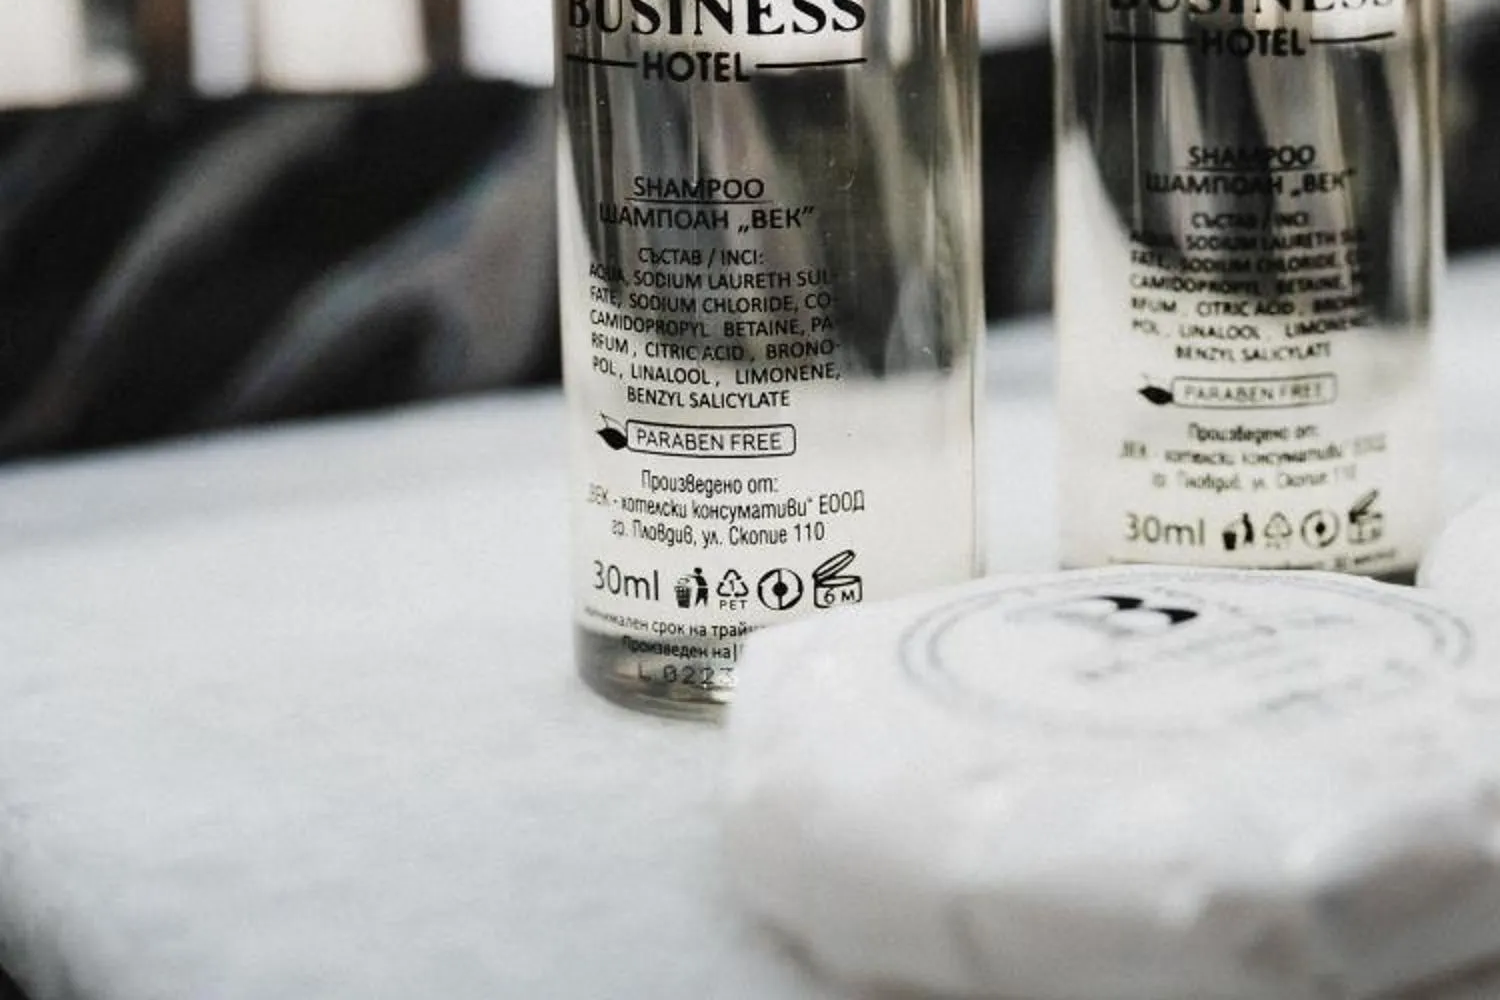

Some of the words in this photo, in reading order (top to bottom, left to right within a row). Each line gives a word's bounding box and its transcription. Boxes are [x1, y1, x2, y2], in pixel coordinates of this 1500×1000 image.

[1201, 28, 1307, 58] HOTEL
[642, 51, 750, 83] HOTEL
[633, 175, 765, 200] SHAMPOO
[600, 203, 729, 231] ШАМПОАН
[721, 249, 765, 266] INCI:
[633, 269, 703, 290] SODIUM
[707, 271, 792, 291] LAURETH
[628, 293, 697, 313] SODIUM
[701, 294, 799, 314] CHLORIDE,
[589, 308, 711, 339] CAMIDOPROPYL
[723, 318, 806, 338] BETAINE,
[645, 341, 699, 361] CITRIC
[735, 361, 842, 385] LIMONENE,
[627, 385, 685, 409] BENZYL
[689, 389, 791, 409] SALICYLATE
[636, 427, 724, 451] PARABEN
[730, 431, 783, 451] FREE
[641, 468, 743, 499] Произведено
[819, 489, 865, 515] ЕООД
[632, 518, 698, 548] Пловдив,
[728, 524, 788, 546] Скопие
[794, 520, 825, 543] 110
[1124, 511, 1206, 547] 30ml
[592, 559, 660, 602] 30ml
[718, 599, 748, 611] PET
[651, 620, 686, 641] срок
